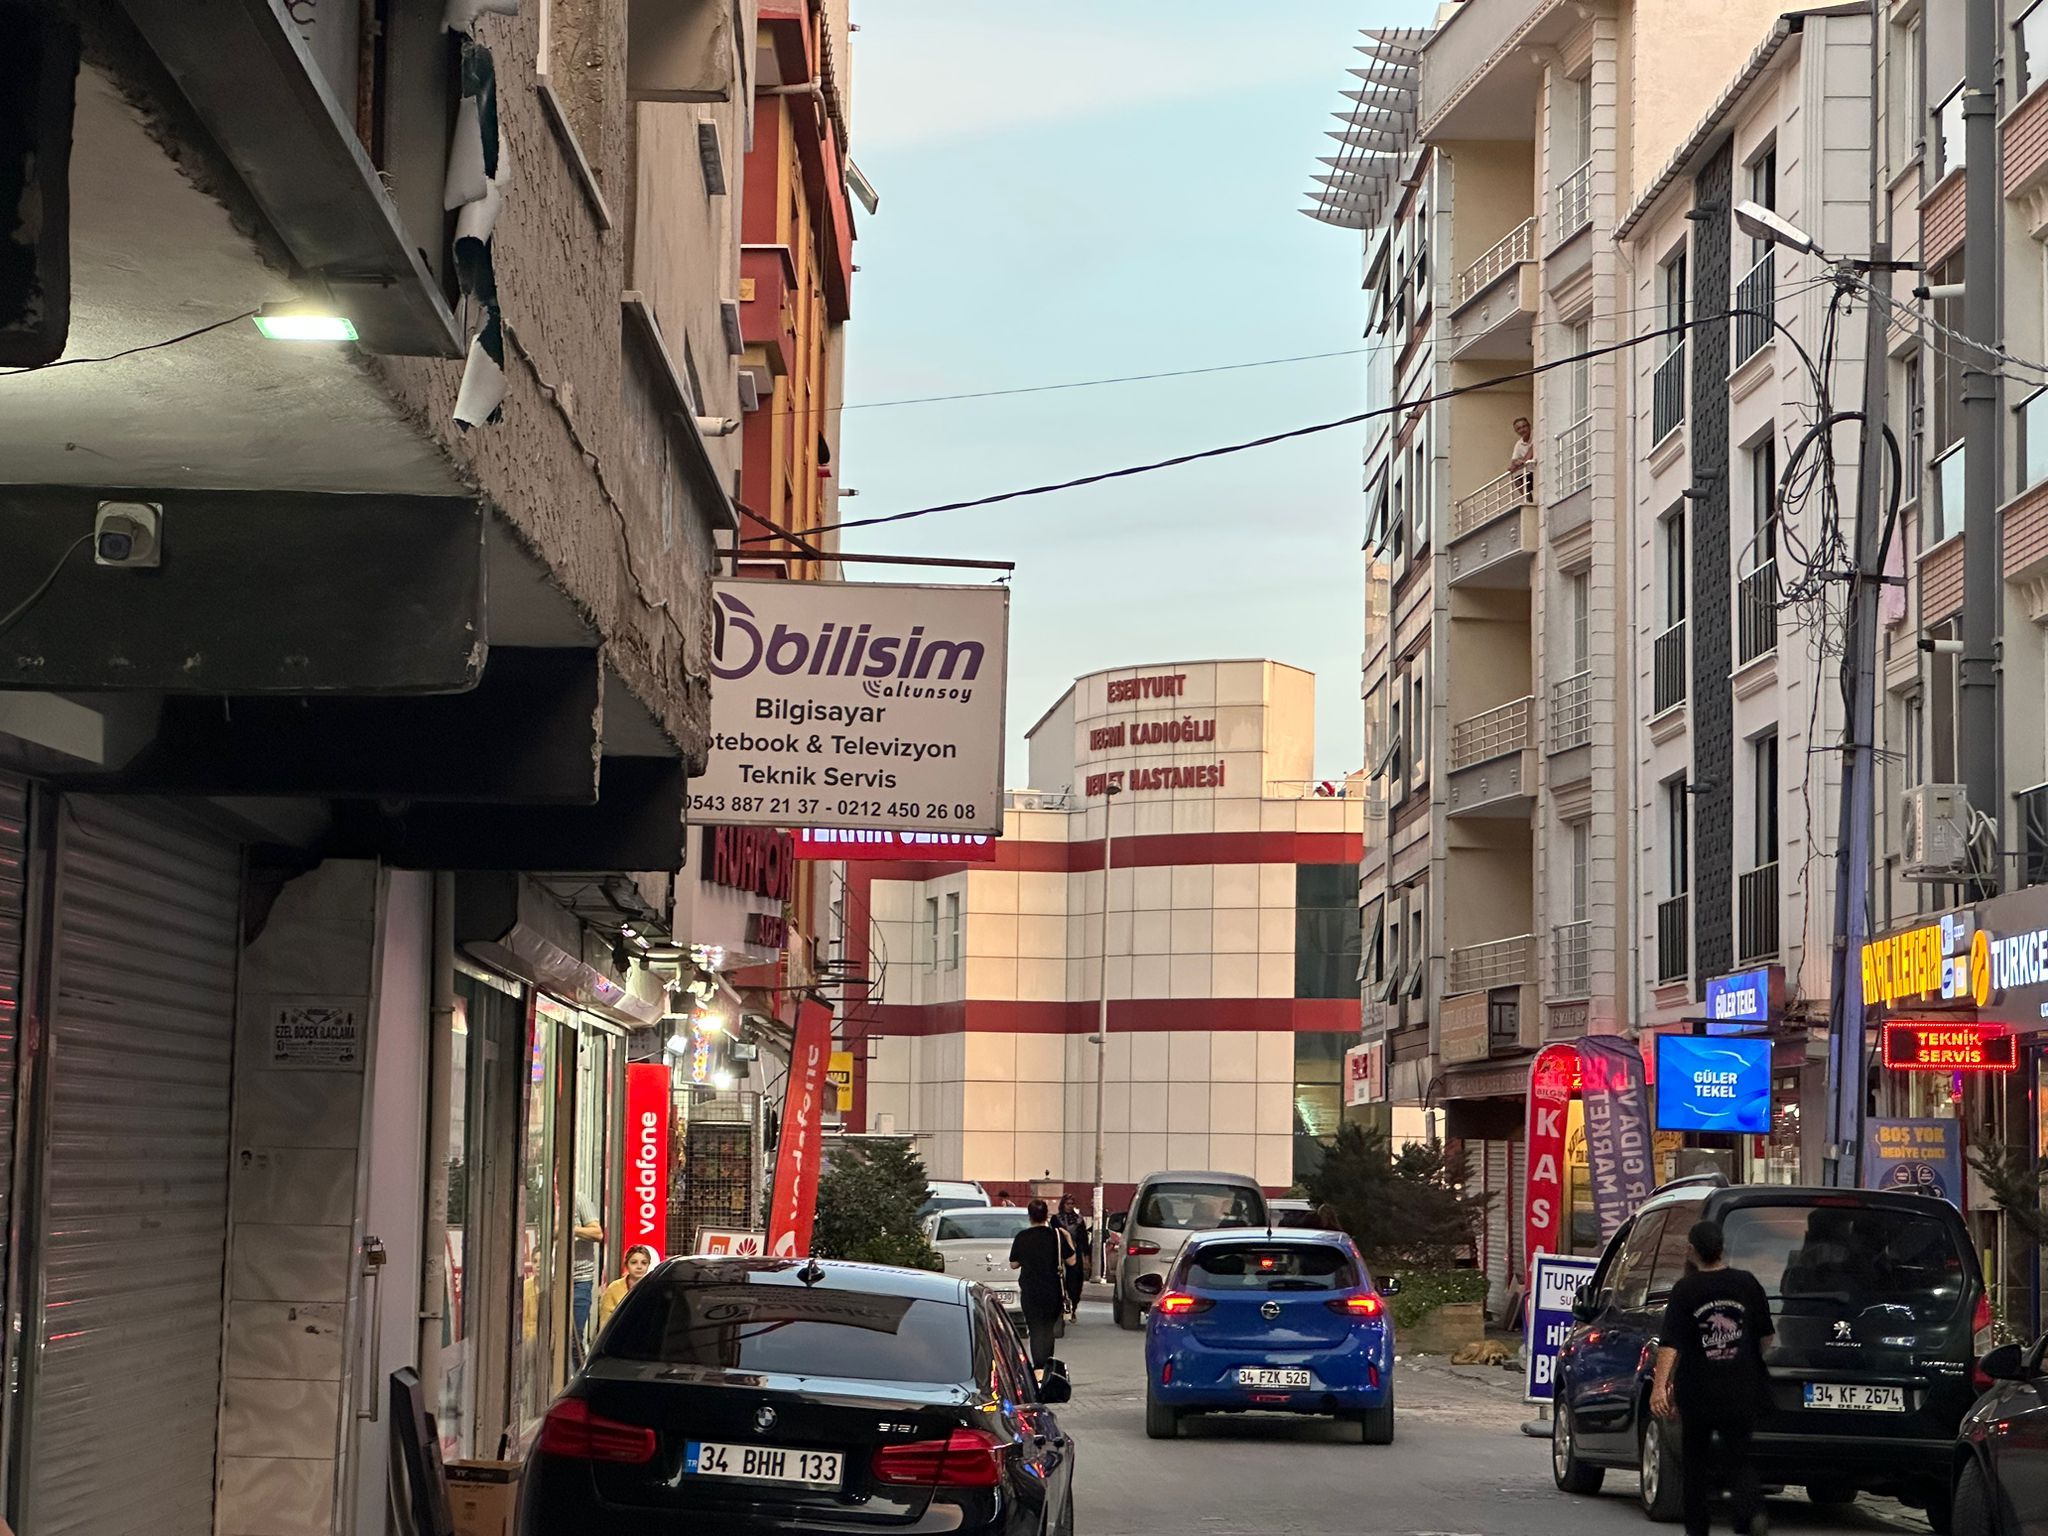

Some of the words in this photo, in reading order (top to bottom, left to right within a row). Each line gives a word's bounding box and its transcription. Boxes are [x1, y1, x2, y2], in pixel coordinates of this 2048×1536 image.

[765, 622, 985, 681] bilisim
[882, 680, 973, 703] altunsoy
[1107, 674, 1186, 703] ESENYURT
[755, 698, 886, 727] Bilgisayar
[1130, 715, 1216, 745] KADIOĞLU
[806, 734, 823, 754] &
[831, 736, 957, 762] Televizyon
[738, 764, 816, 786] Teknik
[824, 767, 897, 789] Servis
[1129, 760, 1225, 791] HASTANESİ
[731, 796, 764, 812] 887
[769, 797, 790, 813] 21
[797, 798, 819, 814] 37
[837, 801, 881, 817] 0212
[887, 802, 920, 818] 450
[925, 803, 948, 819] 26
[954, 804, 976, 820] 08
[1917, 1029, 1982, 1046] TEKNİK
[1918, 1047, 1982, 1063] SERVİS
[1694, 1069, 1737, 1085] GÜLER
[1695, 1085, 1736, 1098] TEKEL
[634, 1111, 657, 1235] vodafone
[1240, 1370, 1254, 1384] 34
[1259, 1370, 1281, 1384] FZK
[1286, 1370, 1308, 1384] 526
[1815, 1386, 1833, 1403] 34
[1840, 1387, 1857, 1403] KF
[1865, 1388, 1899, 1405] 2674
[701, 1446, 728, 1473] 34
[742, 1451, 786, 1477] BHH
[799, 1454, 838, 1481] 133
